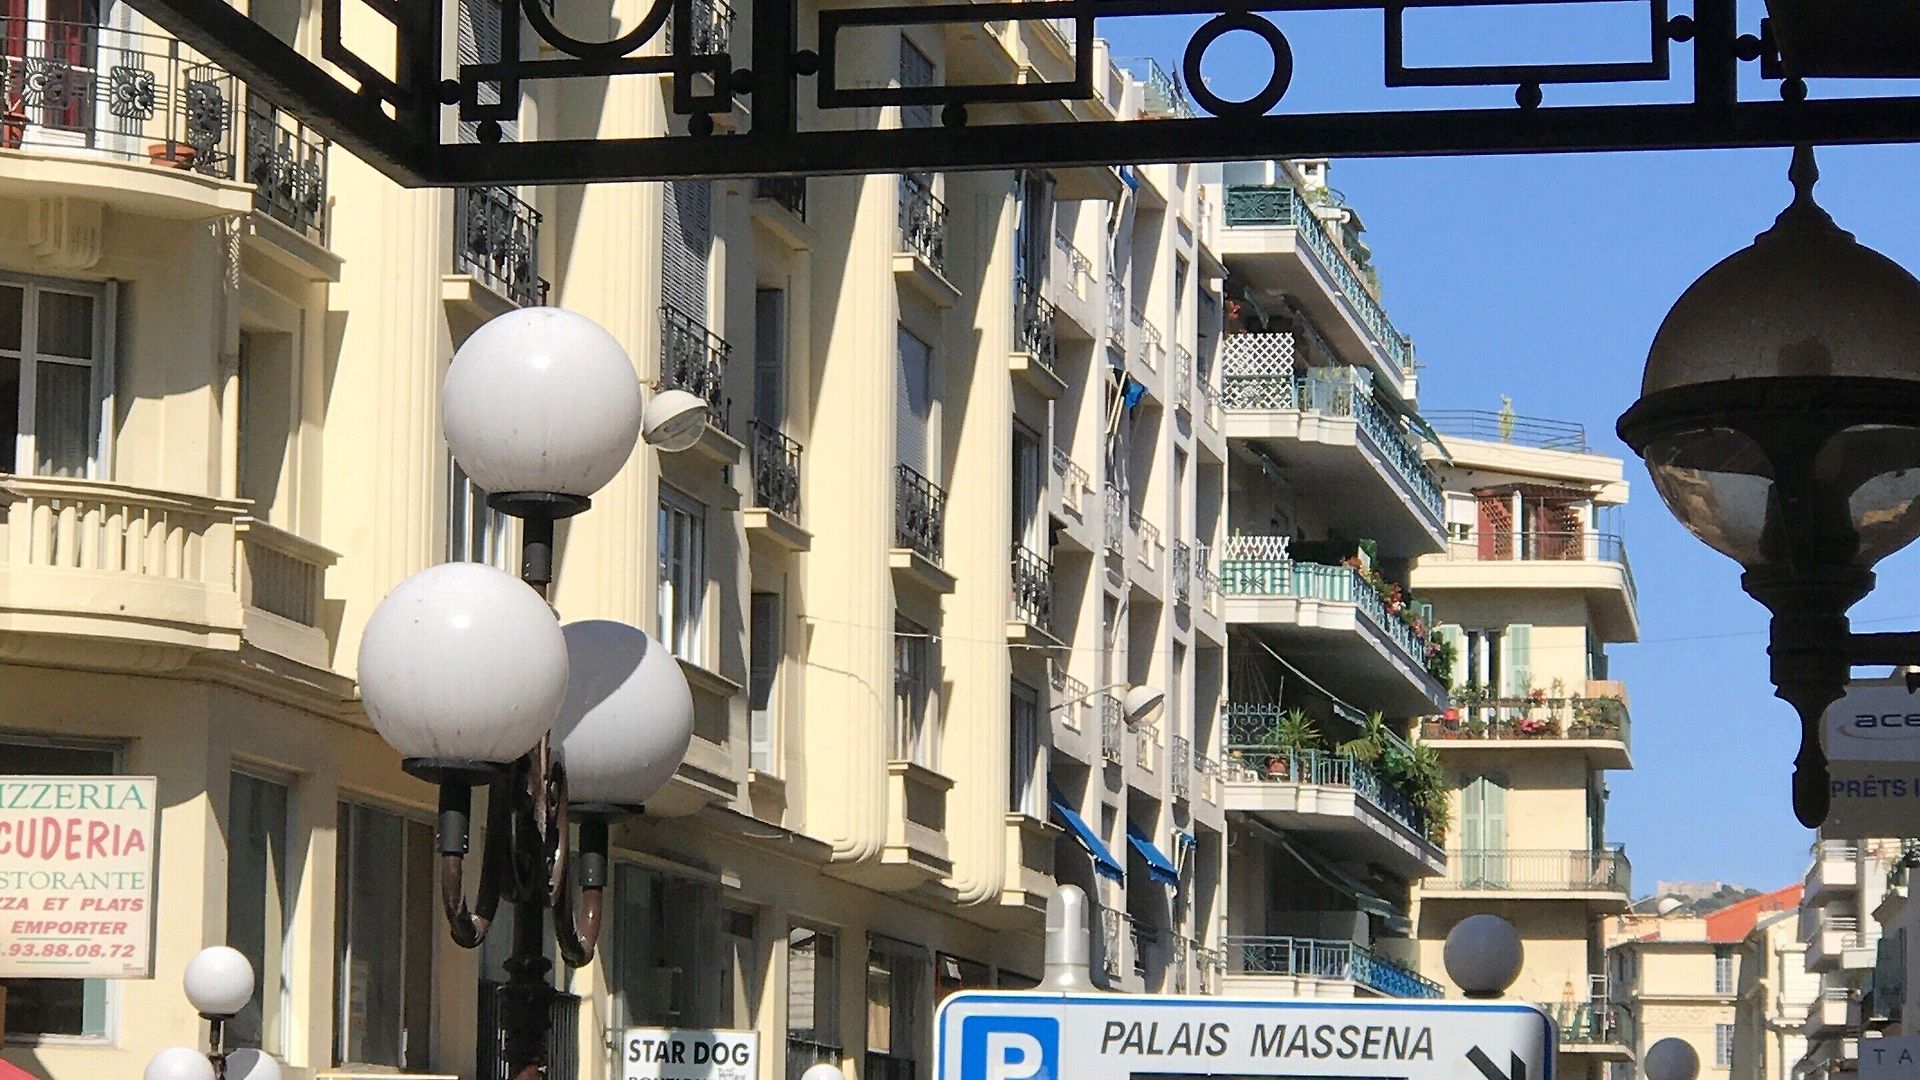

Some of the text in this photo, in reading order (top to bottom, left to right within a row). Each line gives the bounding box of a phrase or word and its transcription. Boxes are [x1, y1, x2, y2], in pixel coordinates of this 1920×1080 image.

[1832, 774, 1907, 798] PRÊTS
[0, 816, 145, 861] CUDERIA
[0, 871, 145, 890] STORANTE
[43, 897, 69, 911] ET
[79, 898, 144, 912] PLATS
[11, 921, 128, 935] EMPORTER
[629, 1039, 749, 1066] STAR DOG
[1101, 1021, 1434, 1060] PALAIS MASSENA
[986, 1032, 1043, 1080] P
